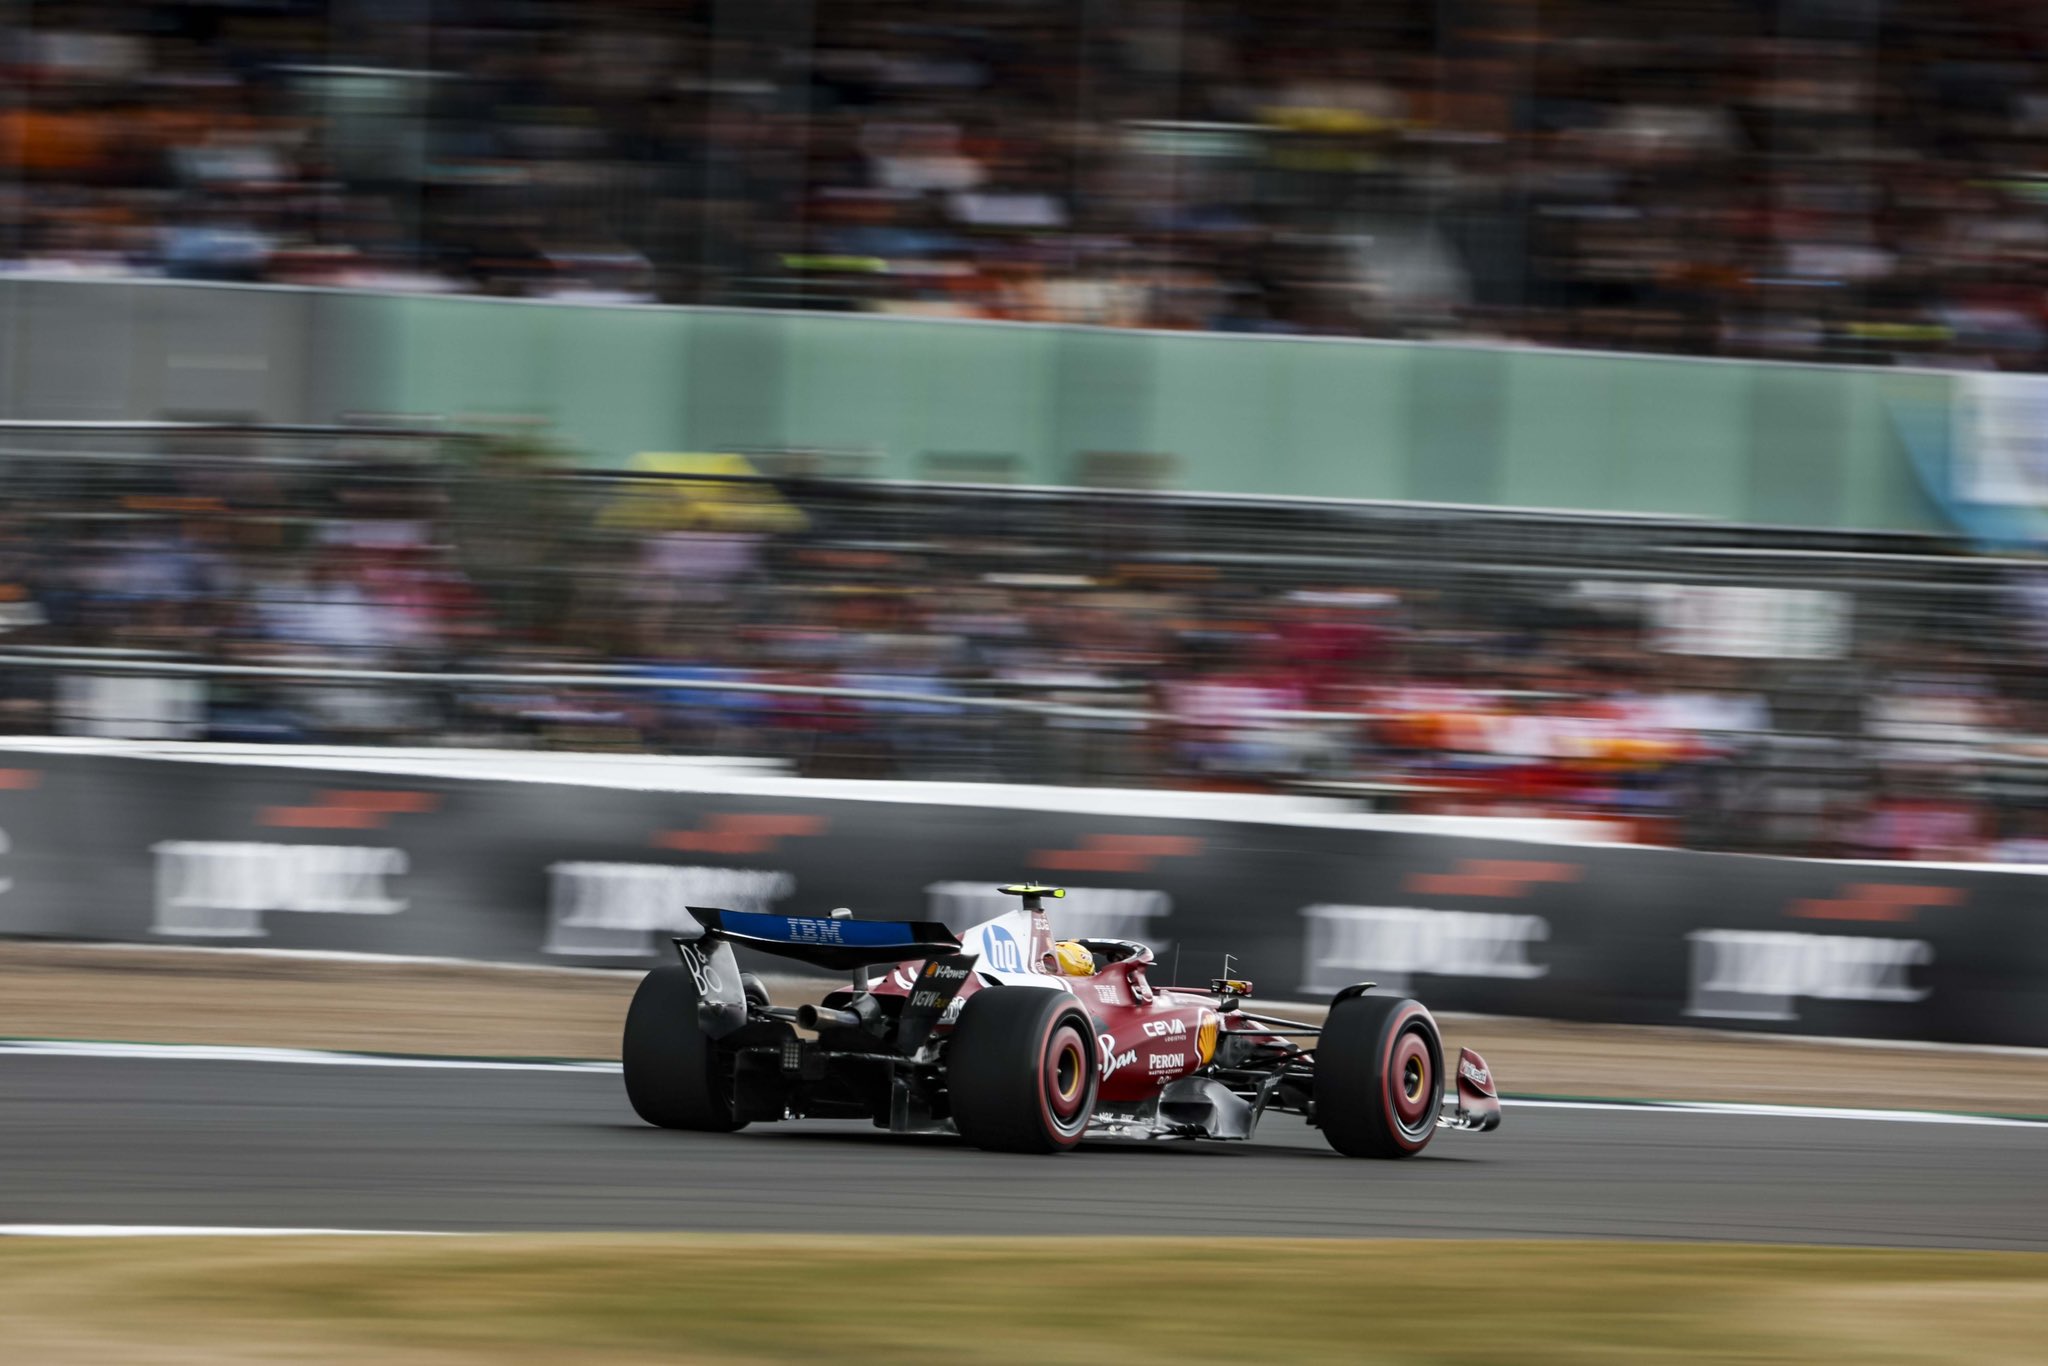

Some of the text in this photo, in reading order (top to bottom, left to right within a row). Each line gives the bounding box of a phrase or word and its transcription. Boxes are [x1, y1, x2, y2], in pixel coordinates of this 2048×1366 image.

[787, 917, 844, 943] IBM
[985, 925, 1020, 973] hp
[935, 965, 969, 979] V-Power
[911, 990, 940, 1008] VGW
[1142, 1018, 1186, 1038] CEVA
[1149, 1053, 1185, 1070] PERONI
